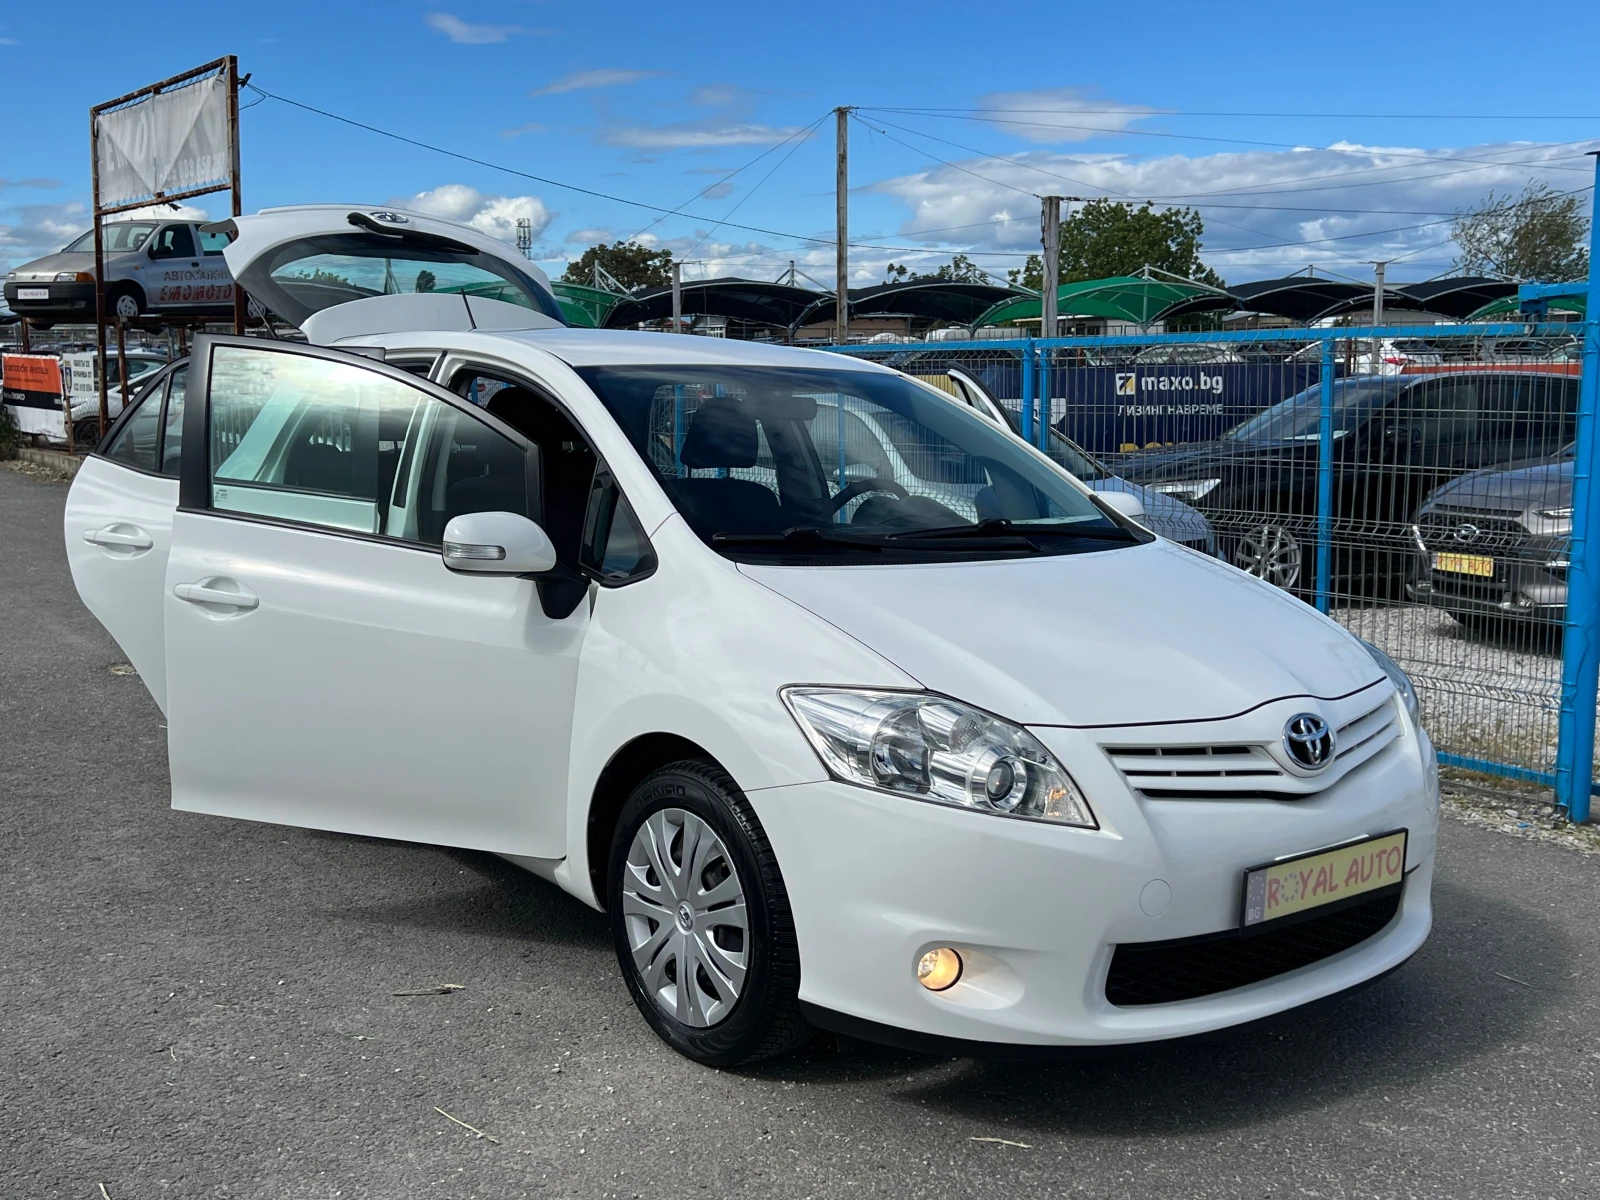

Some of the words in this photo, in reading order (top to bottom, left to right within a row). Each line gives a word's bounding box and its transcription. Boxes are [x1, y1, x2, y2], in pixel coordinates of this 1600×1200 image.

[1141, 372, 1223, 394] maxo.bg
[1168, 403, 1223, 416] НАВРЕМЕ
[1344, 845, 1401, 888] AUTO
[1247, 906, 1261, 921] BG
